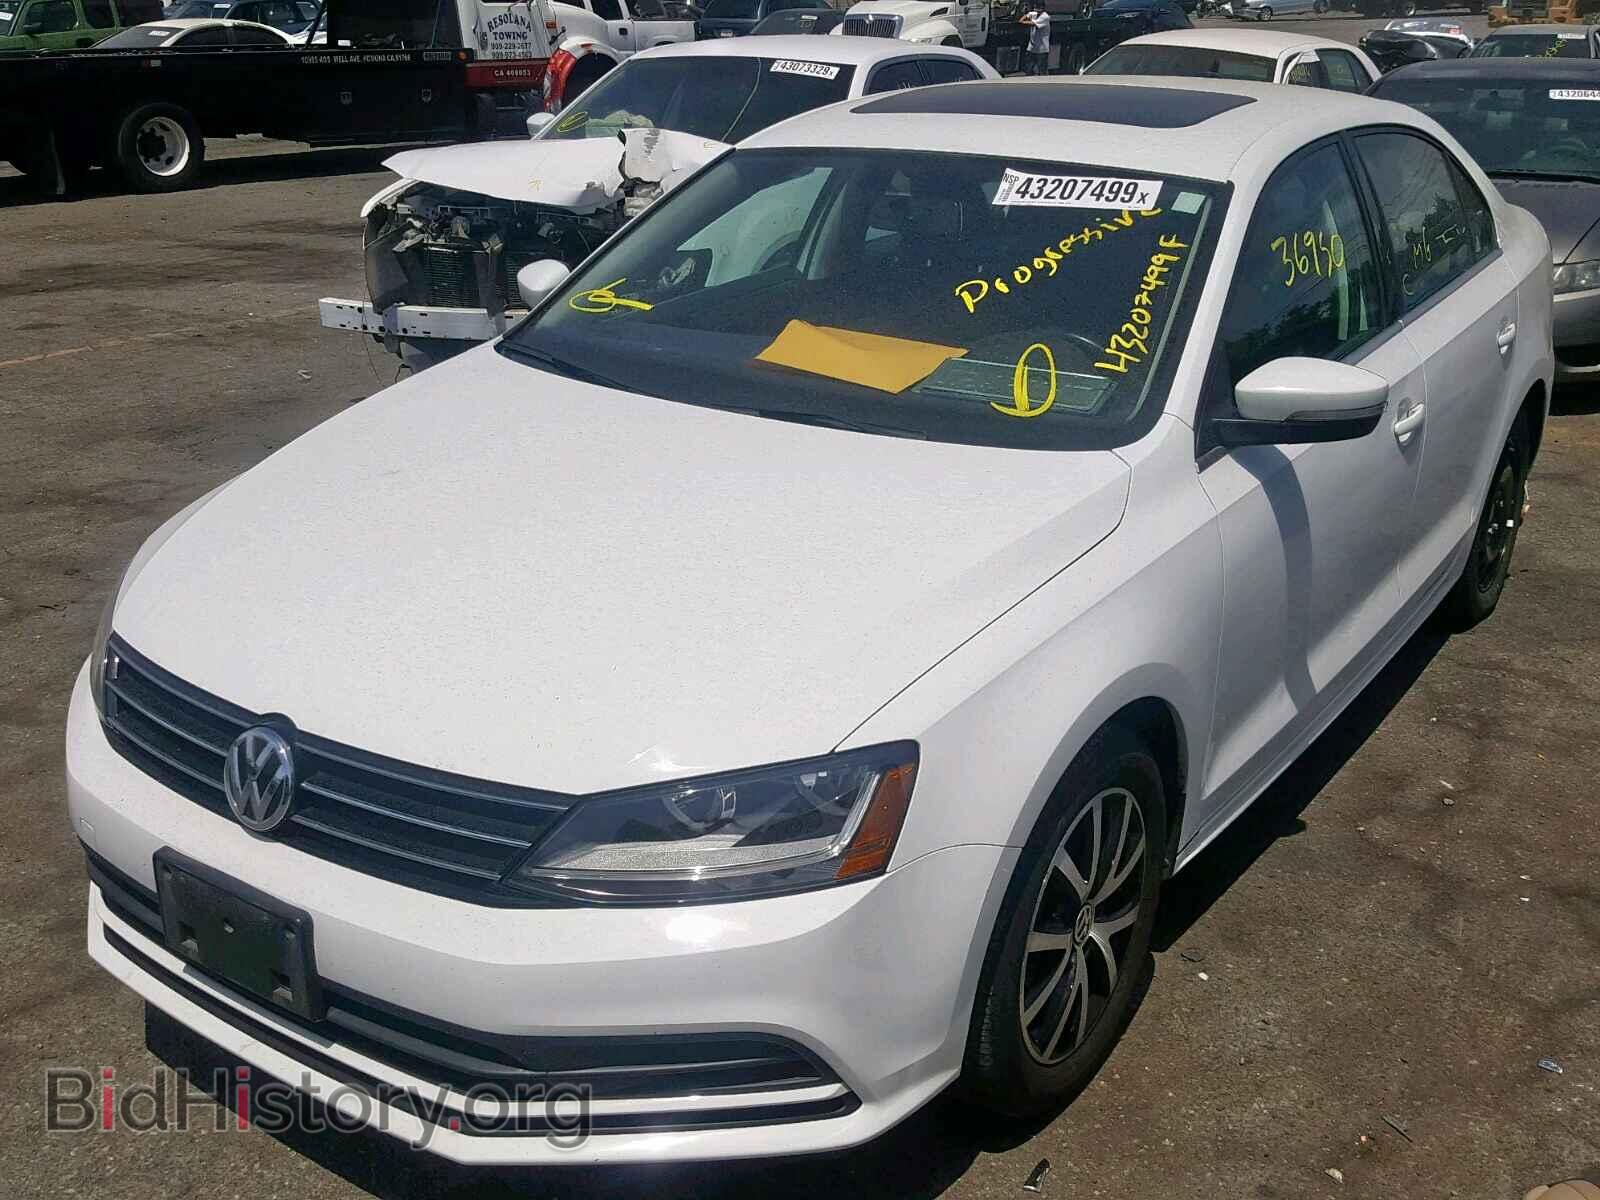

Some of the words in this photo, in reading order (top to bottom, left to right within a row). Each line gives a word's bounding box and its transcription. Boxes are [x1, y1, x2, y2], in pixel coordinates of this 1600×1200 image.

[487, 12, 532, 33] RESOLANA
[493, 31, 528, 41] TOWING
[494, 69, 504, 77] CA
[1002, 173, 1020, 184] NSP
